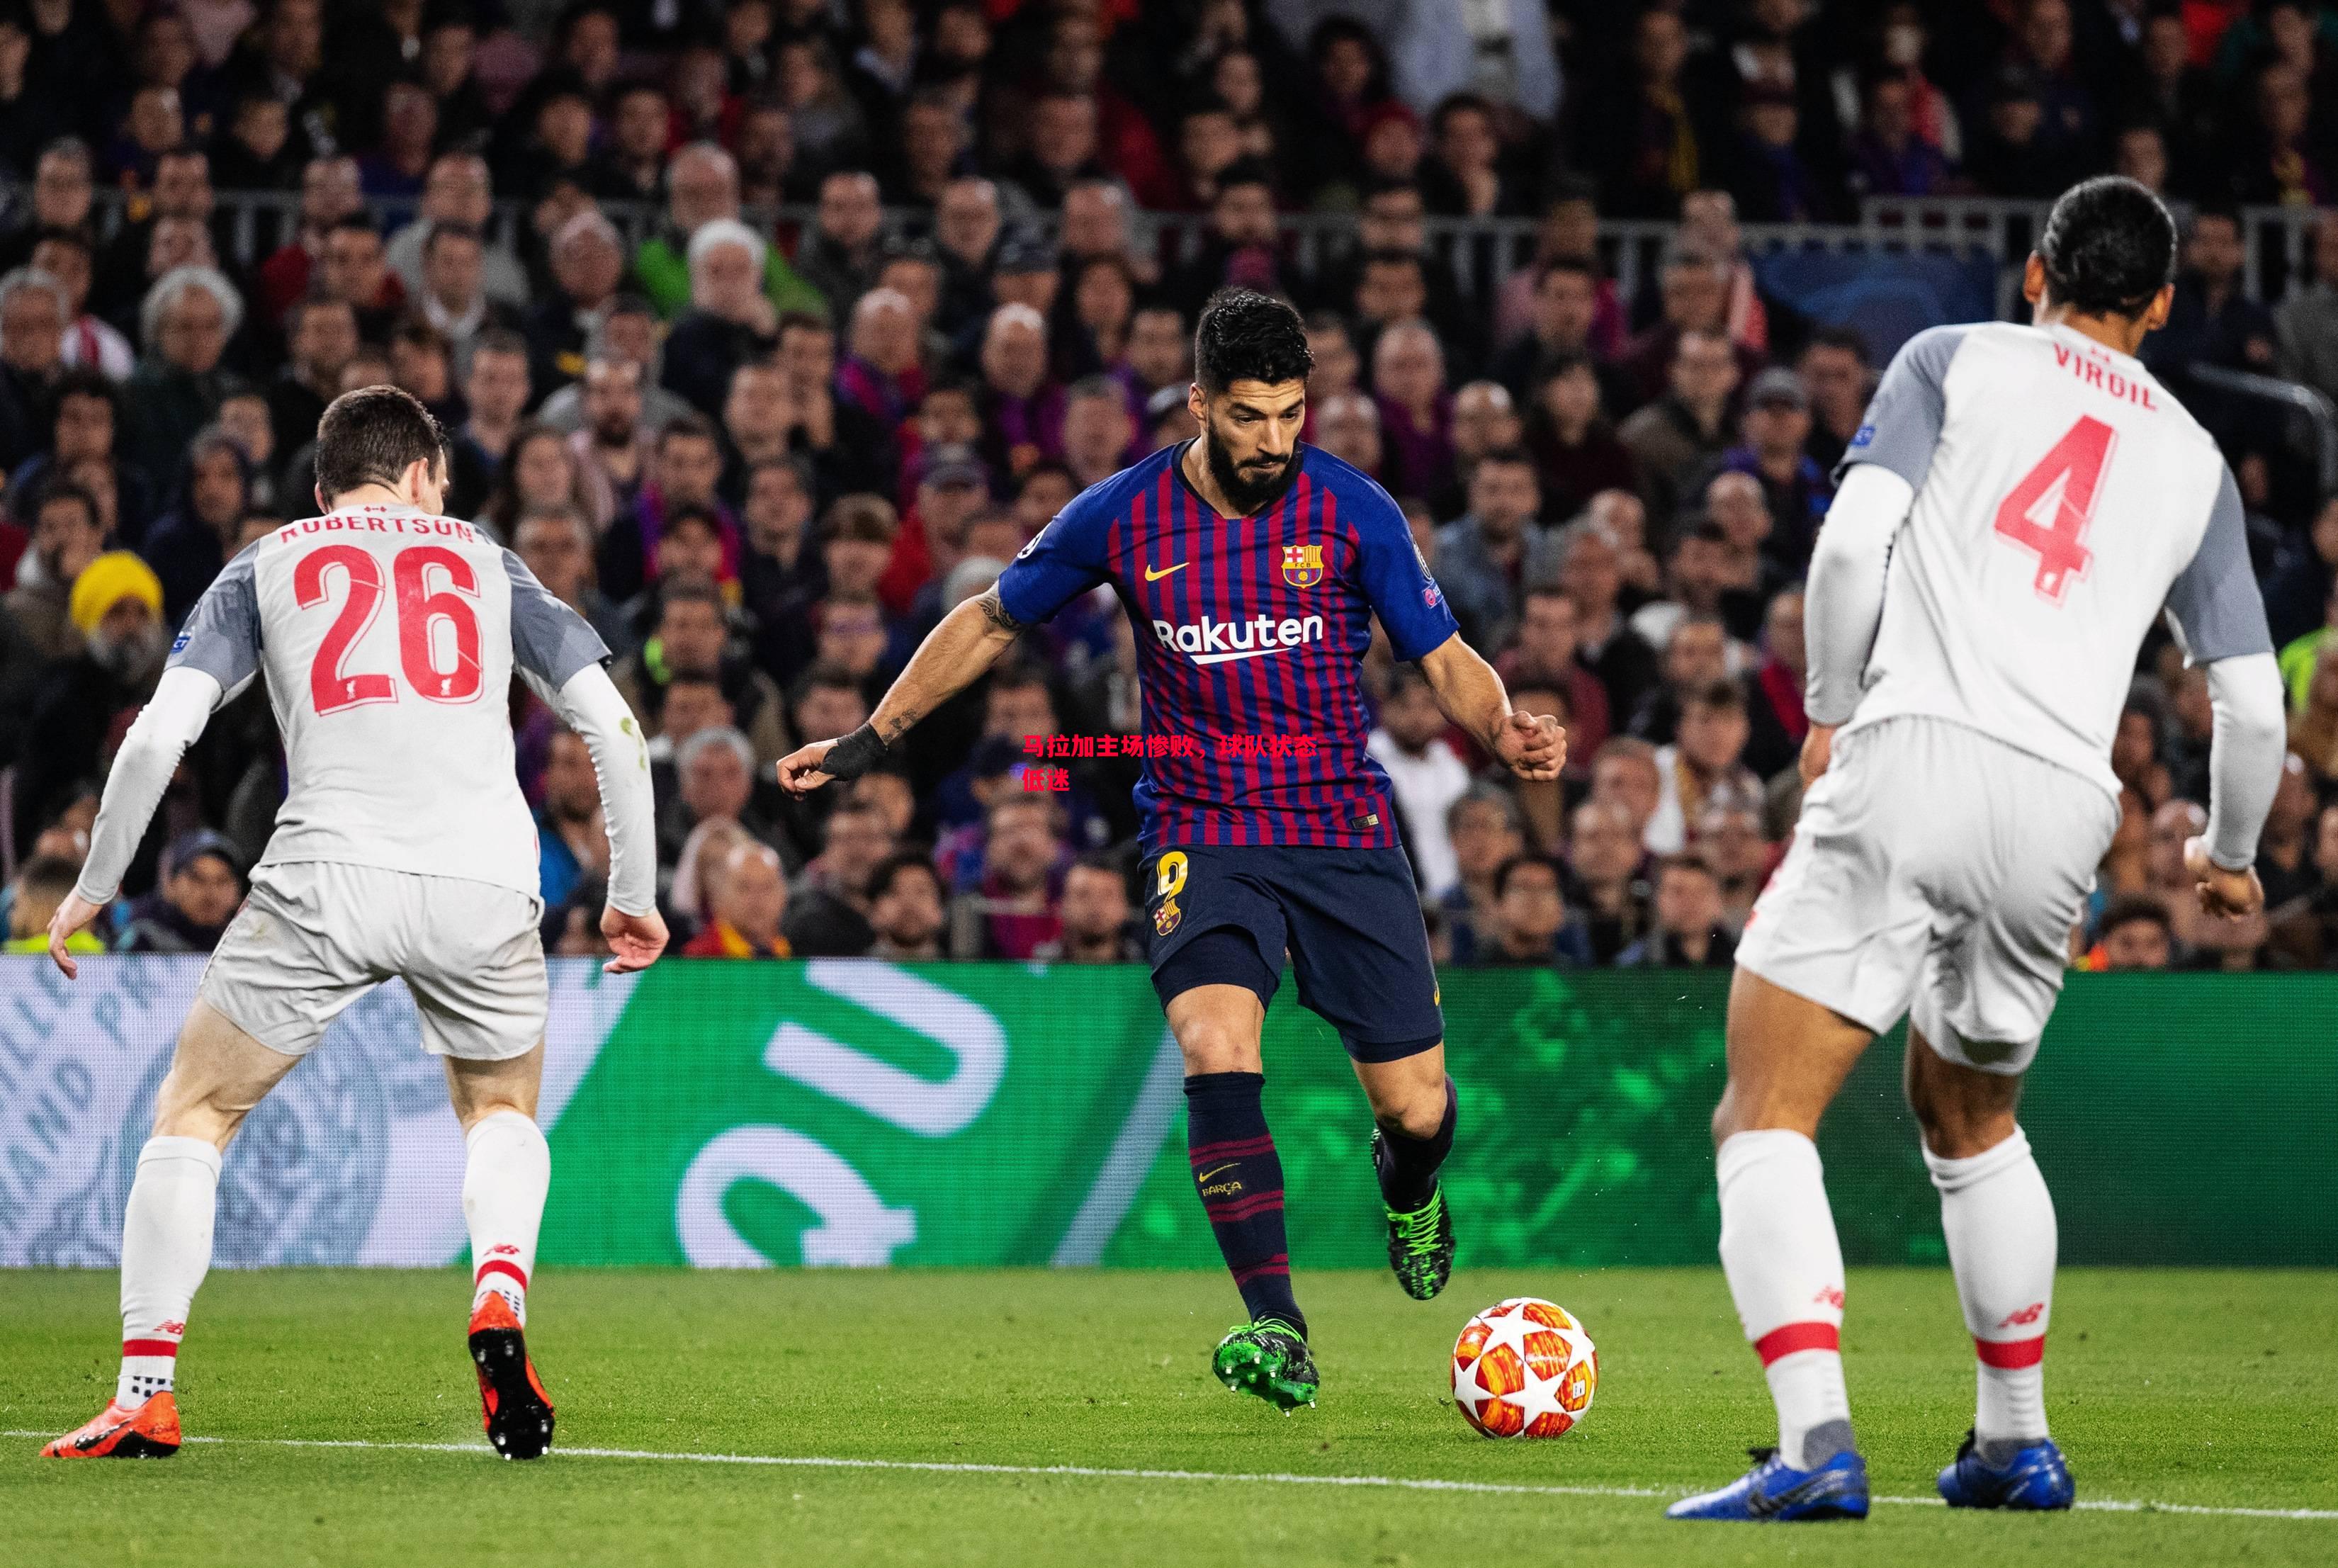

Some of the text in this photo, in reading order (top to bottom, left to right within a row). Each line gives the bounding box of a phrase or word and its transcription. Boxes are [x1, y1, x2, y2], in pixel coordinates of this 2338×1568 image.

[2054, 342, 2157, 411] VIRGIL
[1993, 414, 2118, 609] 4
[294, 544, 484, 716] 26
[1152, 615, 1323, 653] Rakuten
[1157, 851, 1188, 903] 9
